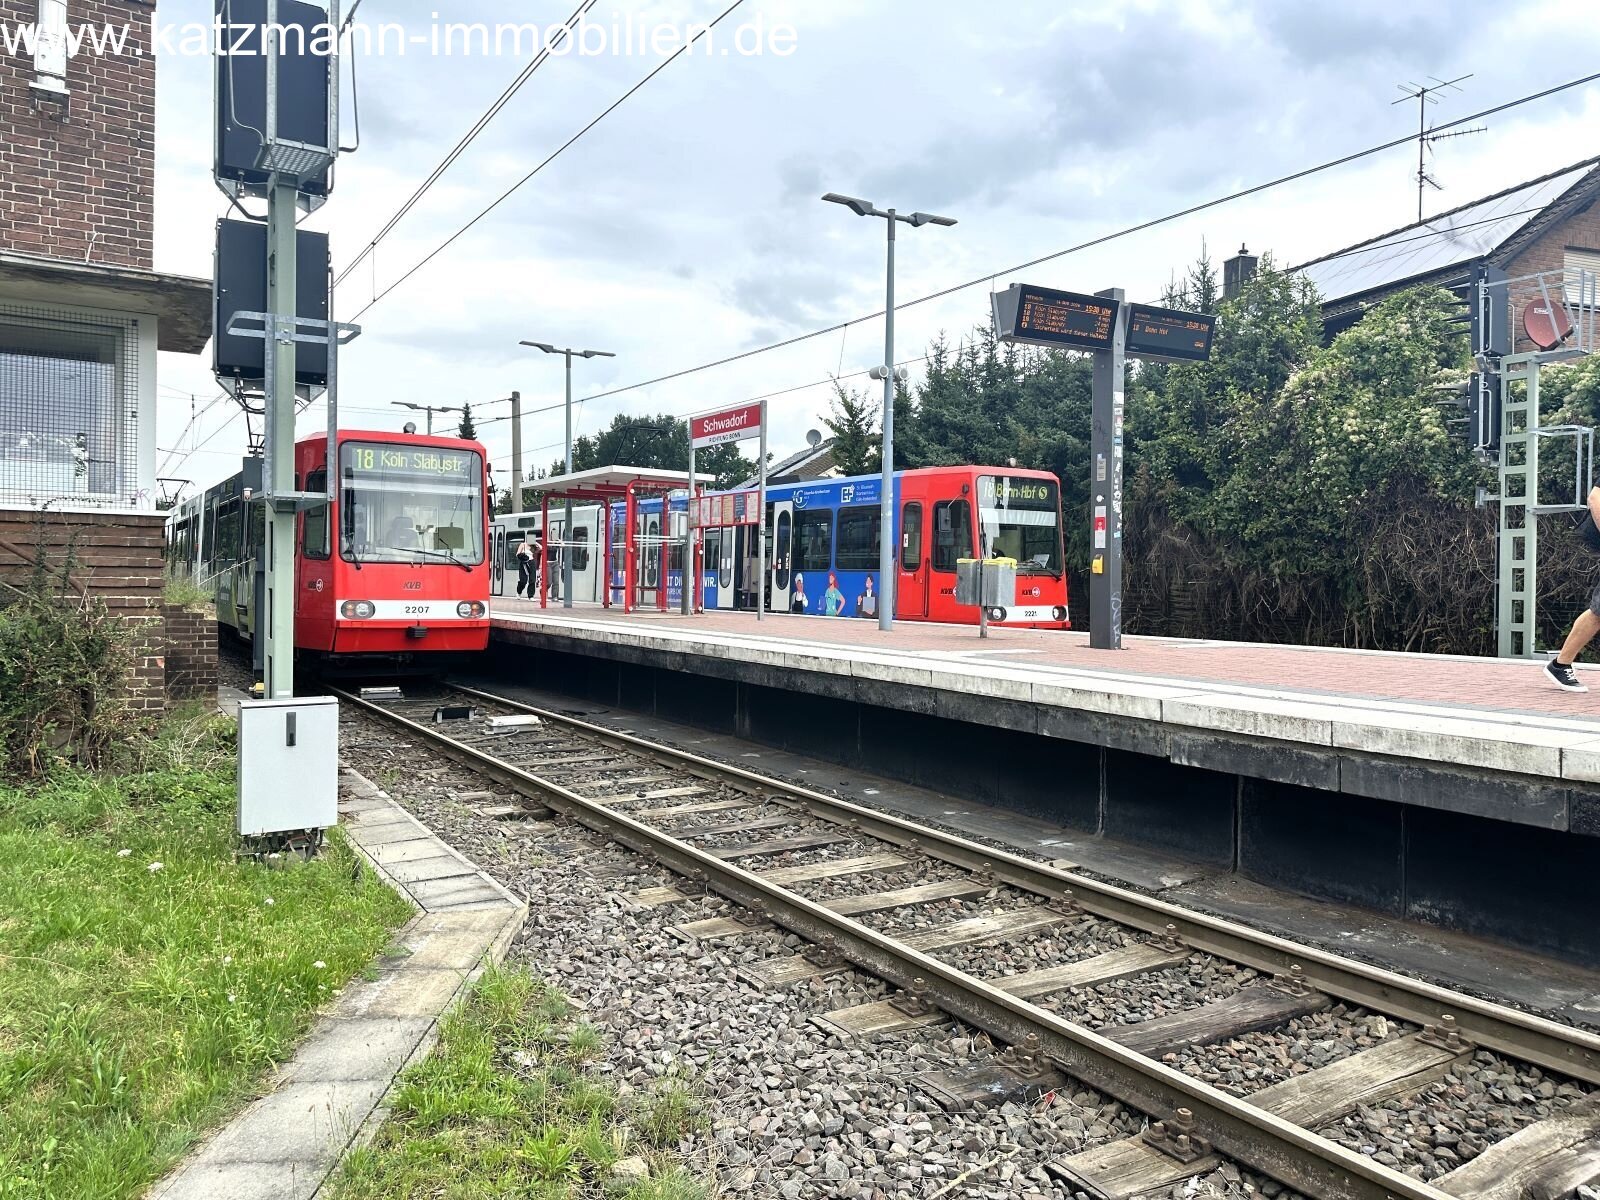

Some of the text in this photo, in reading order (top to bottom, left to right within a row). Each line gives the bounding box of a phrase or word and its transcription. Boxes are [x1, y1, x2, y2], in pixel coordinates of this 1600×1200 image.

[703, 410, 748, 433] Schwadorf
[356, 448, 374, 469] 18
[380, 450, 408, 468] Köln
[1020, 485, 1037, 500] Hbf
[403, 581, 422, 590] KVB
[404, 605, 430, 614] 2207
